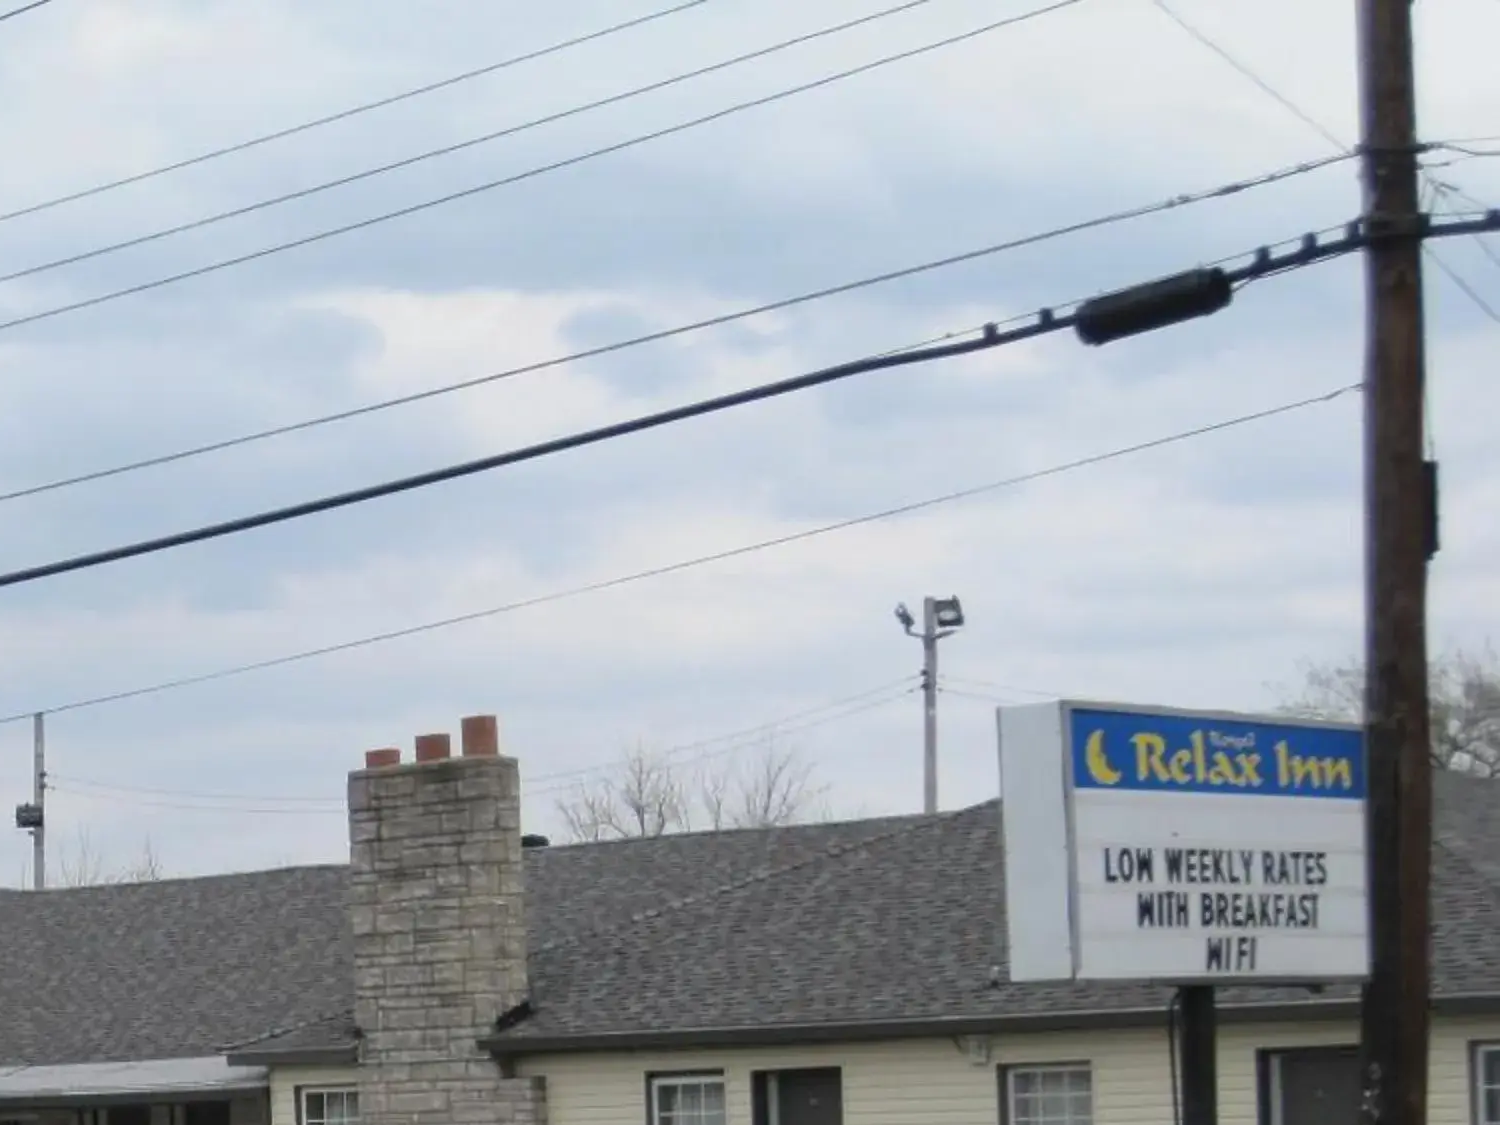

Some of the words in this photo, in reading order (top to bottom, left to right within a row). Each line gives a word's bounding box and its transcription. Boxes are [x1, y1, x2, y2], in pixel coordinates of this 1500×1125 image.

[1130, 730, 1263, 787] Relax
[1274, 740, 1353, 789] Inn
[1105, 848, 1153, 882] LOW
[1164, 849, 1253, 884] WEEKLY
[1262, 852, 1327, 884] RATES
[1137, 893, 1189, 928] WITH
[1200, 893, 1318, 928] BREAKFAST
